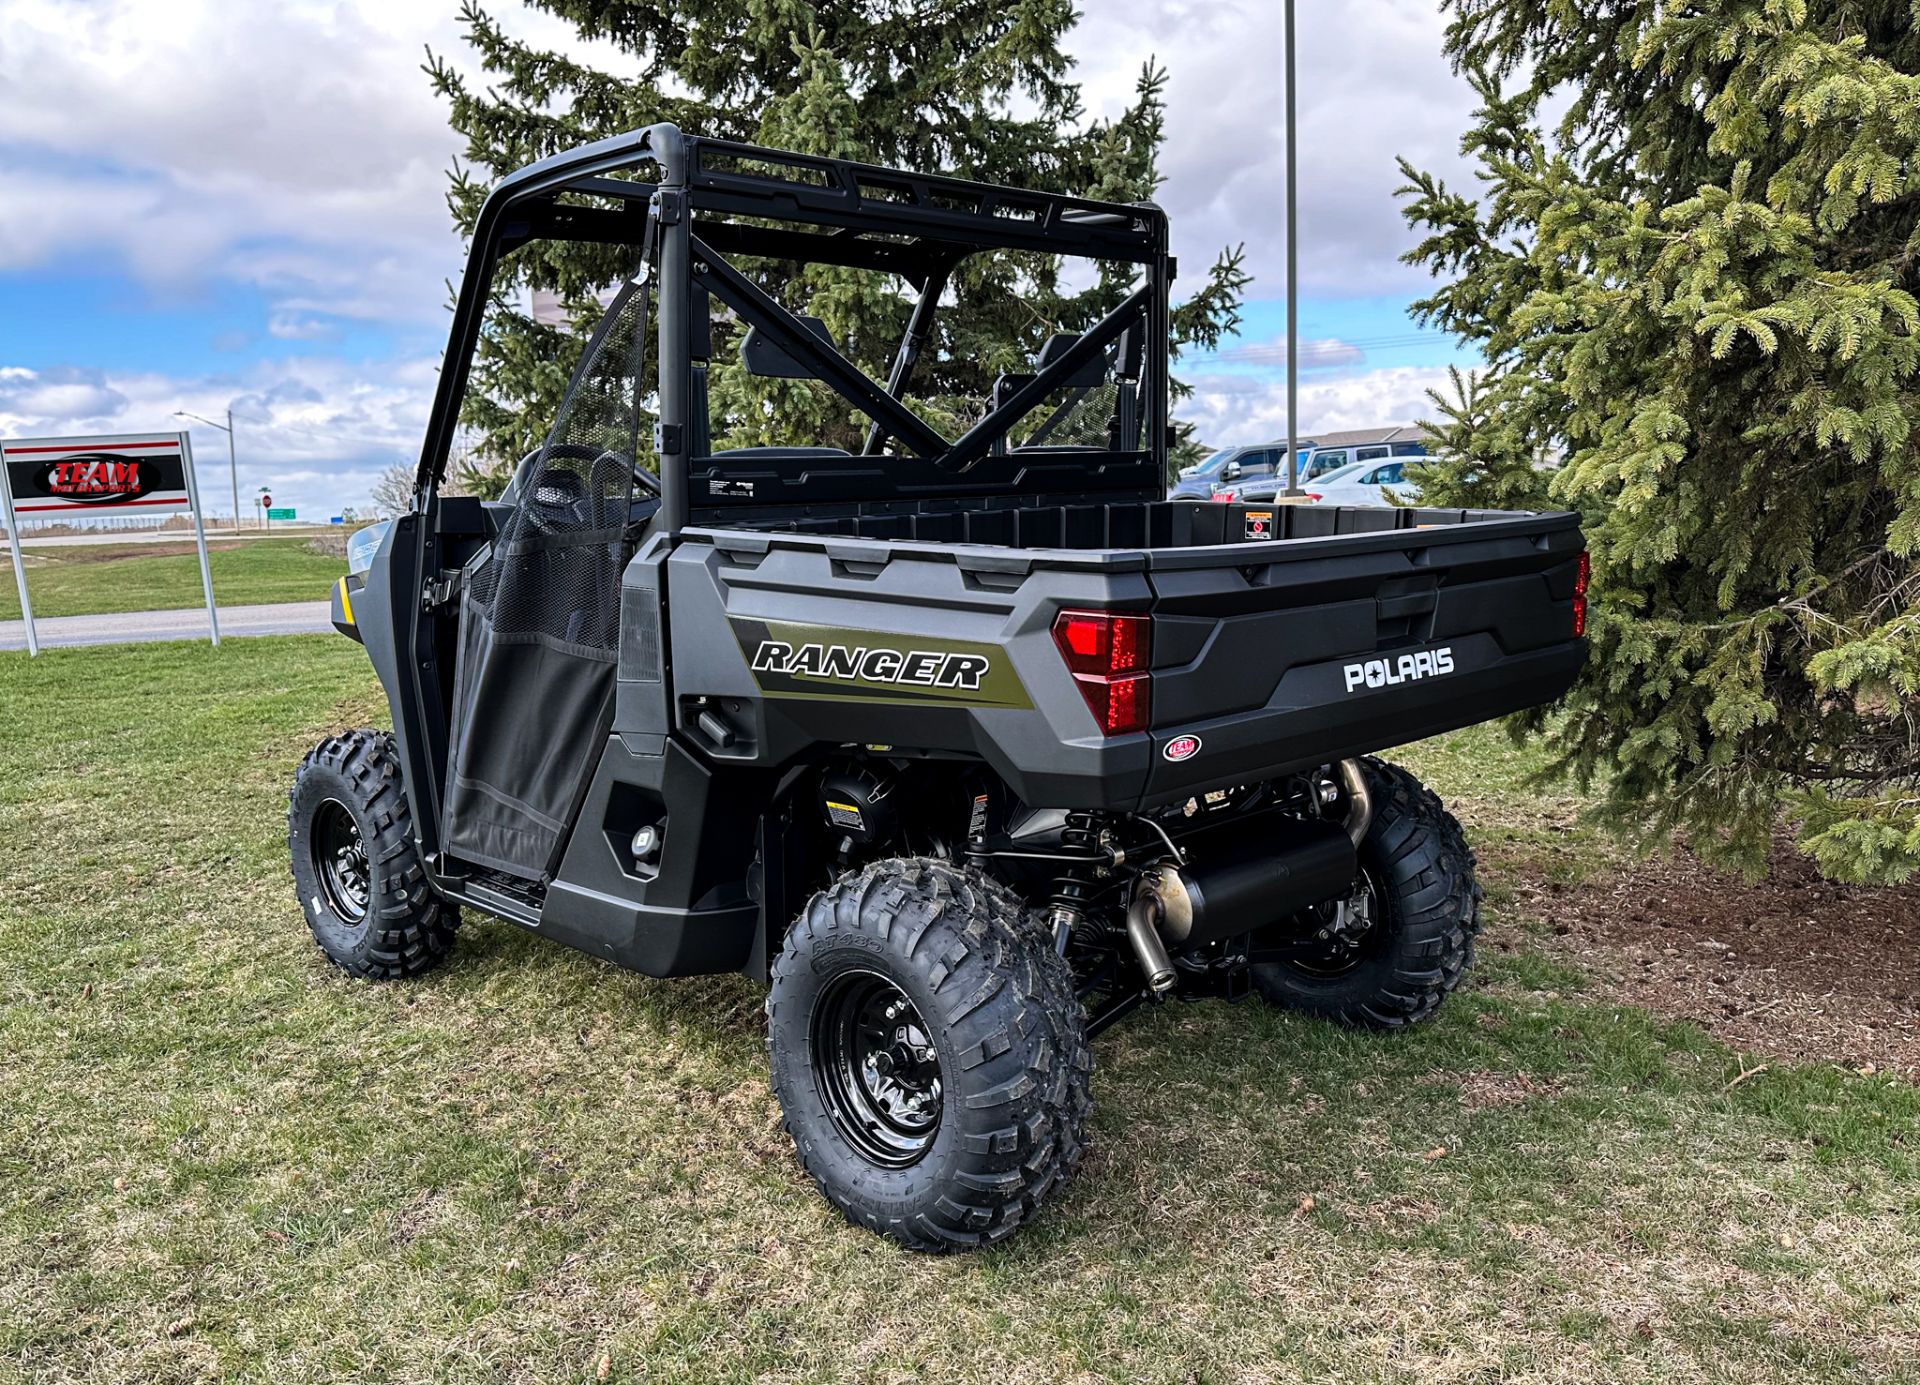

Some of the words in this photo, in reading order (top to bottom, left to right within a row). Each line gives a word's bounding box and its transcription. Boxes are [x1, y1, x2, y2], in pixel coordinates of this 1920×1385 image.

[55, 463, 139, 483] TEAM
[751, 641, 990, 691] RANGER
[1343, 647, 1455, 693] POLARIS
[1170, 739, 1195, 753] TEAM
